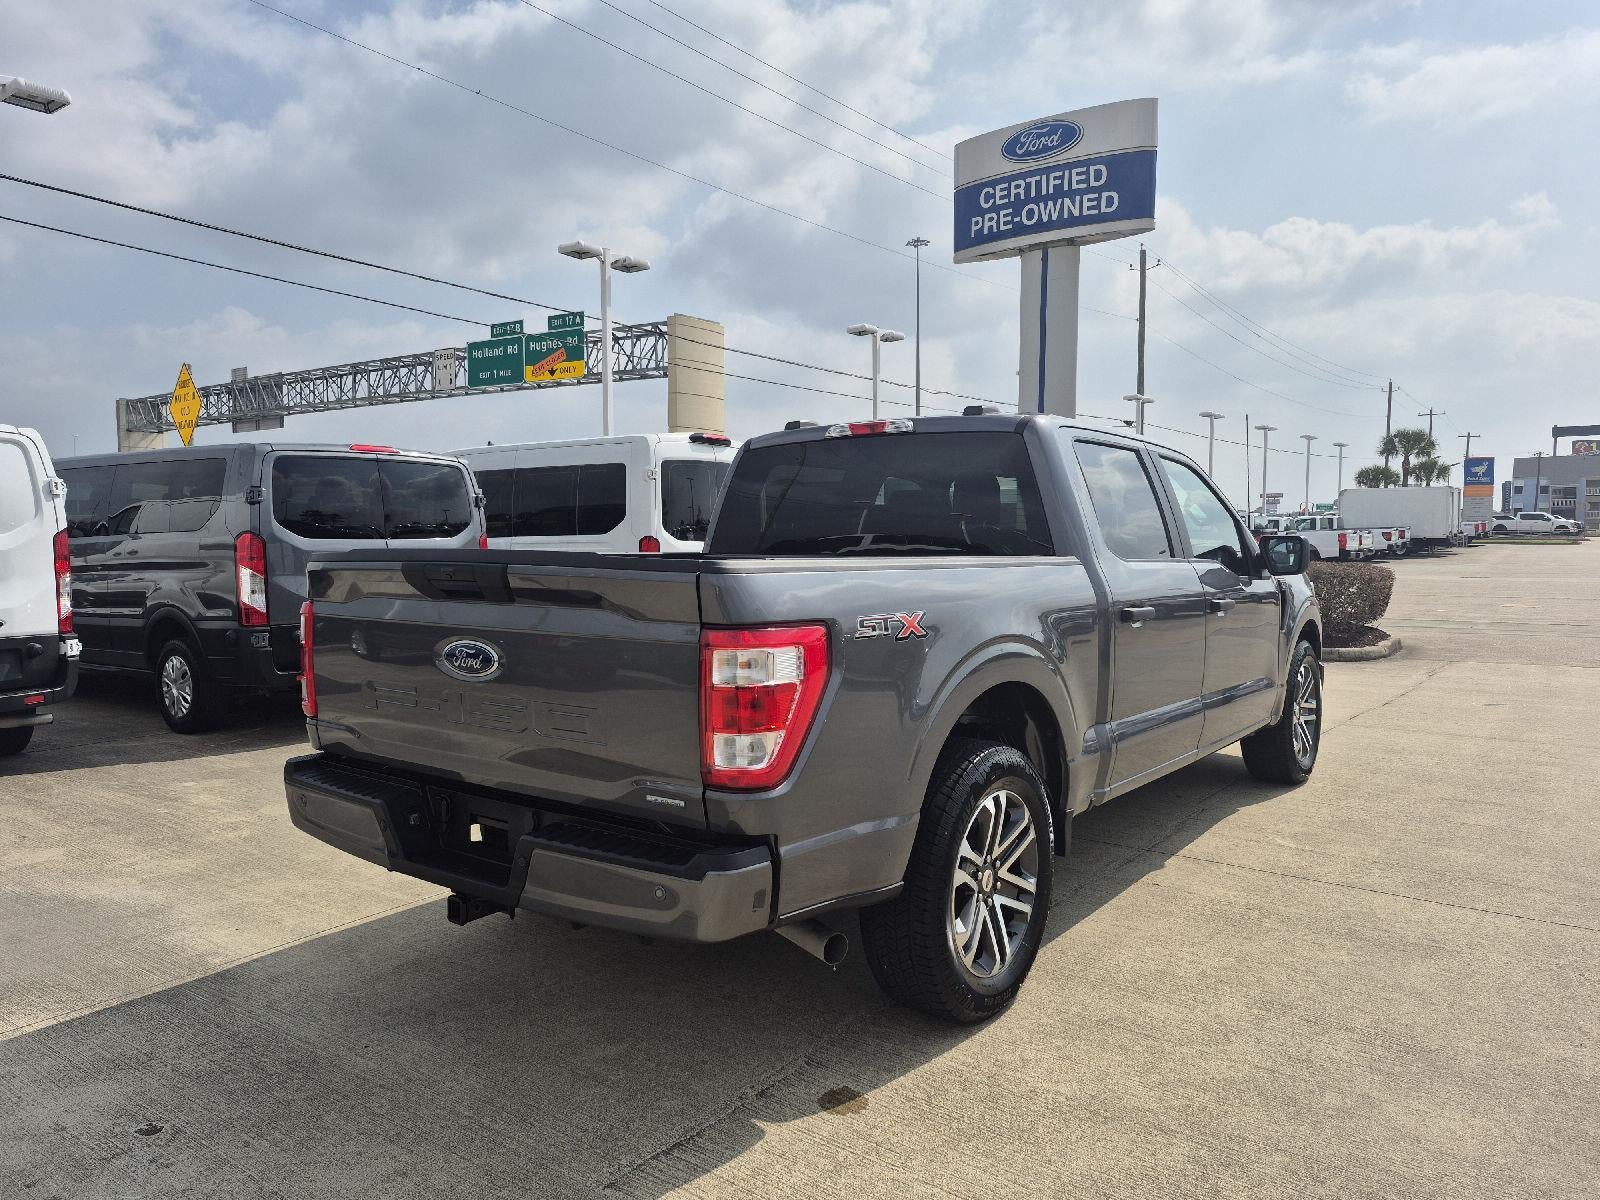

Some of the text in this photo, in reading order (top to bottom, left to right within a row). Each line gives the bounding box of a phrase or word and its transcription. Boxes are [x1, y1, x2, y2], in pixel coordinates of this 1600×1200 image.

[1015, 126, 1064, 155] Ford
[979, 164, 1108, 209] CERTIFIED
[970, 190, 1119, 238] PRE-OWNED
[551, 317, 563, 326] EXIT
[493, 326, 504, 335] EXIT
[472, 343, 518, 359] Holland Rd
[529, 339, 563, 352] Hughes
[435, 352, 454, 362] SPEED
[479, 371, 491, 379] EXIT
[499, 369, 512, 377] MILE
[559, 366, 577, 375] ONLY
[854, 610, 930, 642] STX
[452, 647, 484, 669] Ford
